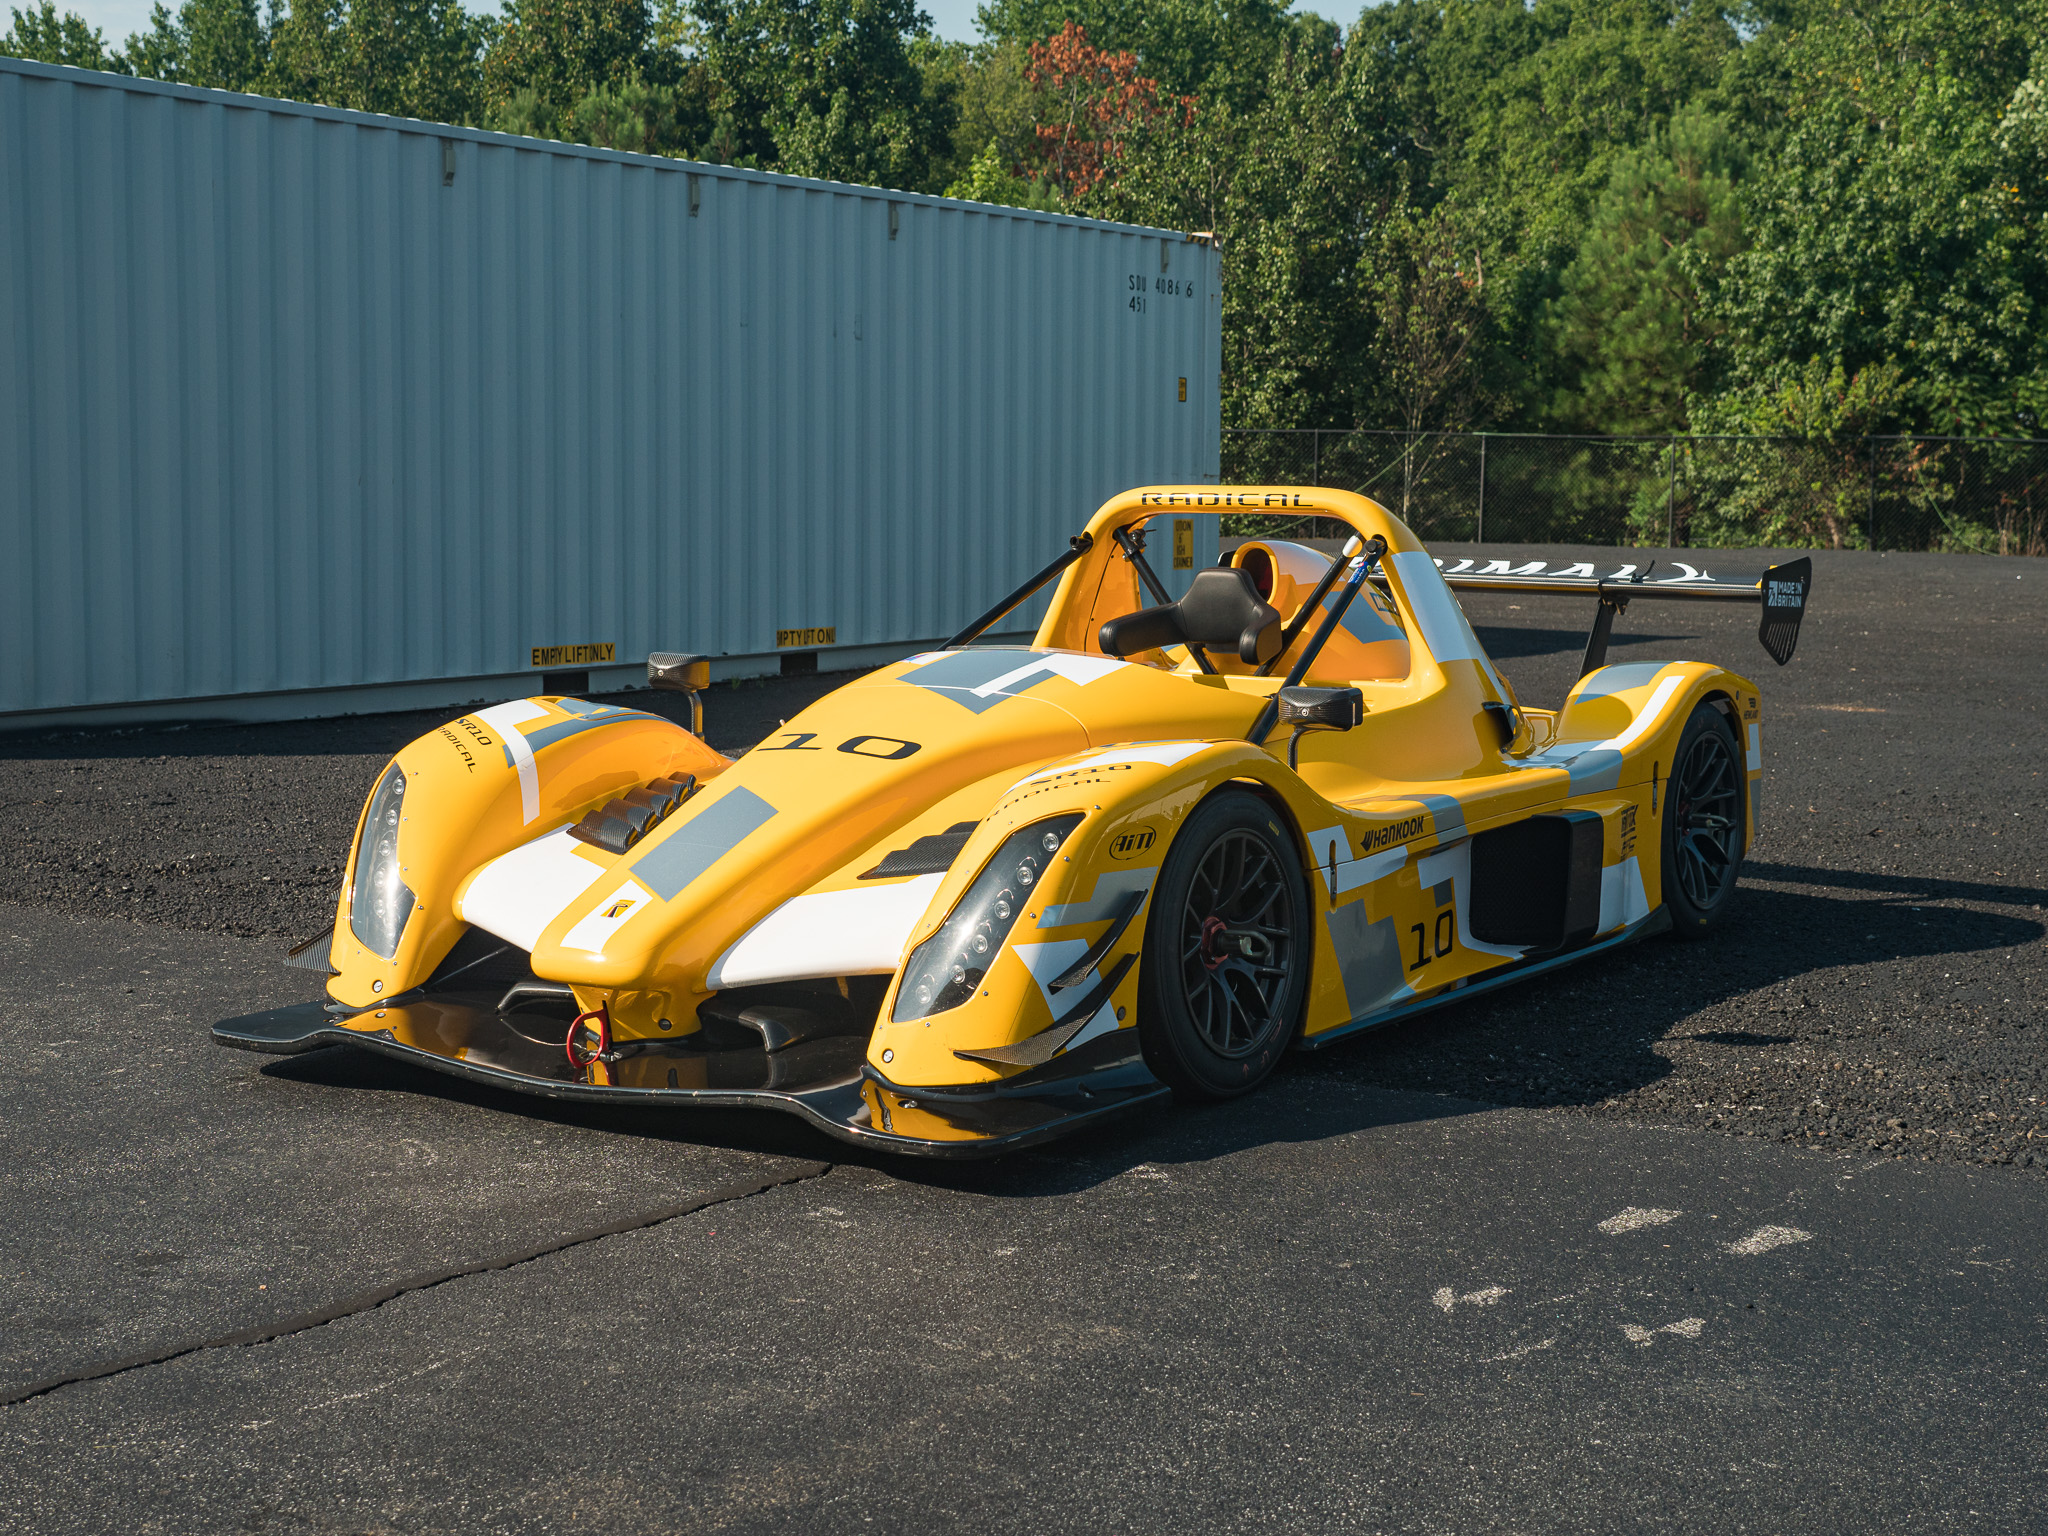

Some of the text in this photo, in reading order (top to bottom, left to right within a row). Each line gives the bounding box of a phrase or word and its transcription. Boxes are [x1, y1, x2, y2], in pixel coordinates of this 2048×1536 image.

[1141, 492, 1314, 507] RADICAL
[1778, 581, 1795, 594] MADE
[1777, 594, 1802, 608] BRITAIN
[532, 647, 563, 666] EMPY
[565, 645, 588, 663] LIFT
[455, 718, 493, 746] SR10
[437, 726, 476, 774] RADICAL
[755, 732, 923, 761] 10
[1030, 764, 1132, 787] SR10
[985, 778, 1112, 823] RADICAL
[1409, 909, 1454, 973] 10
